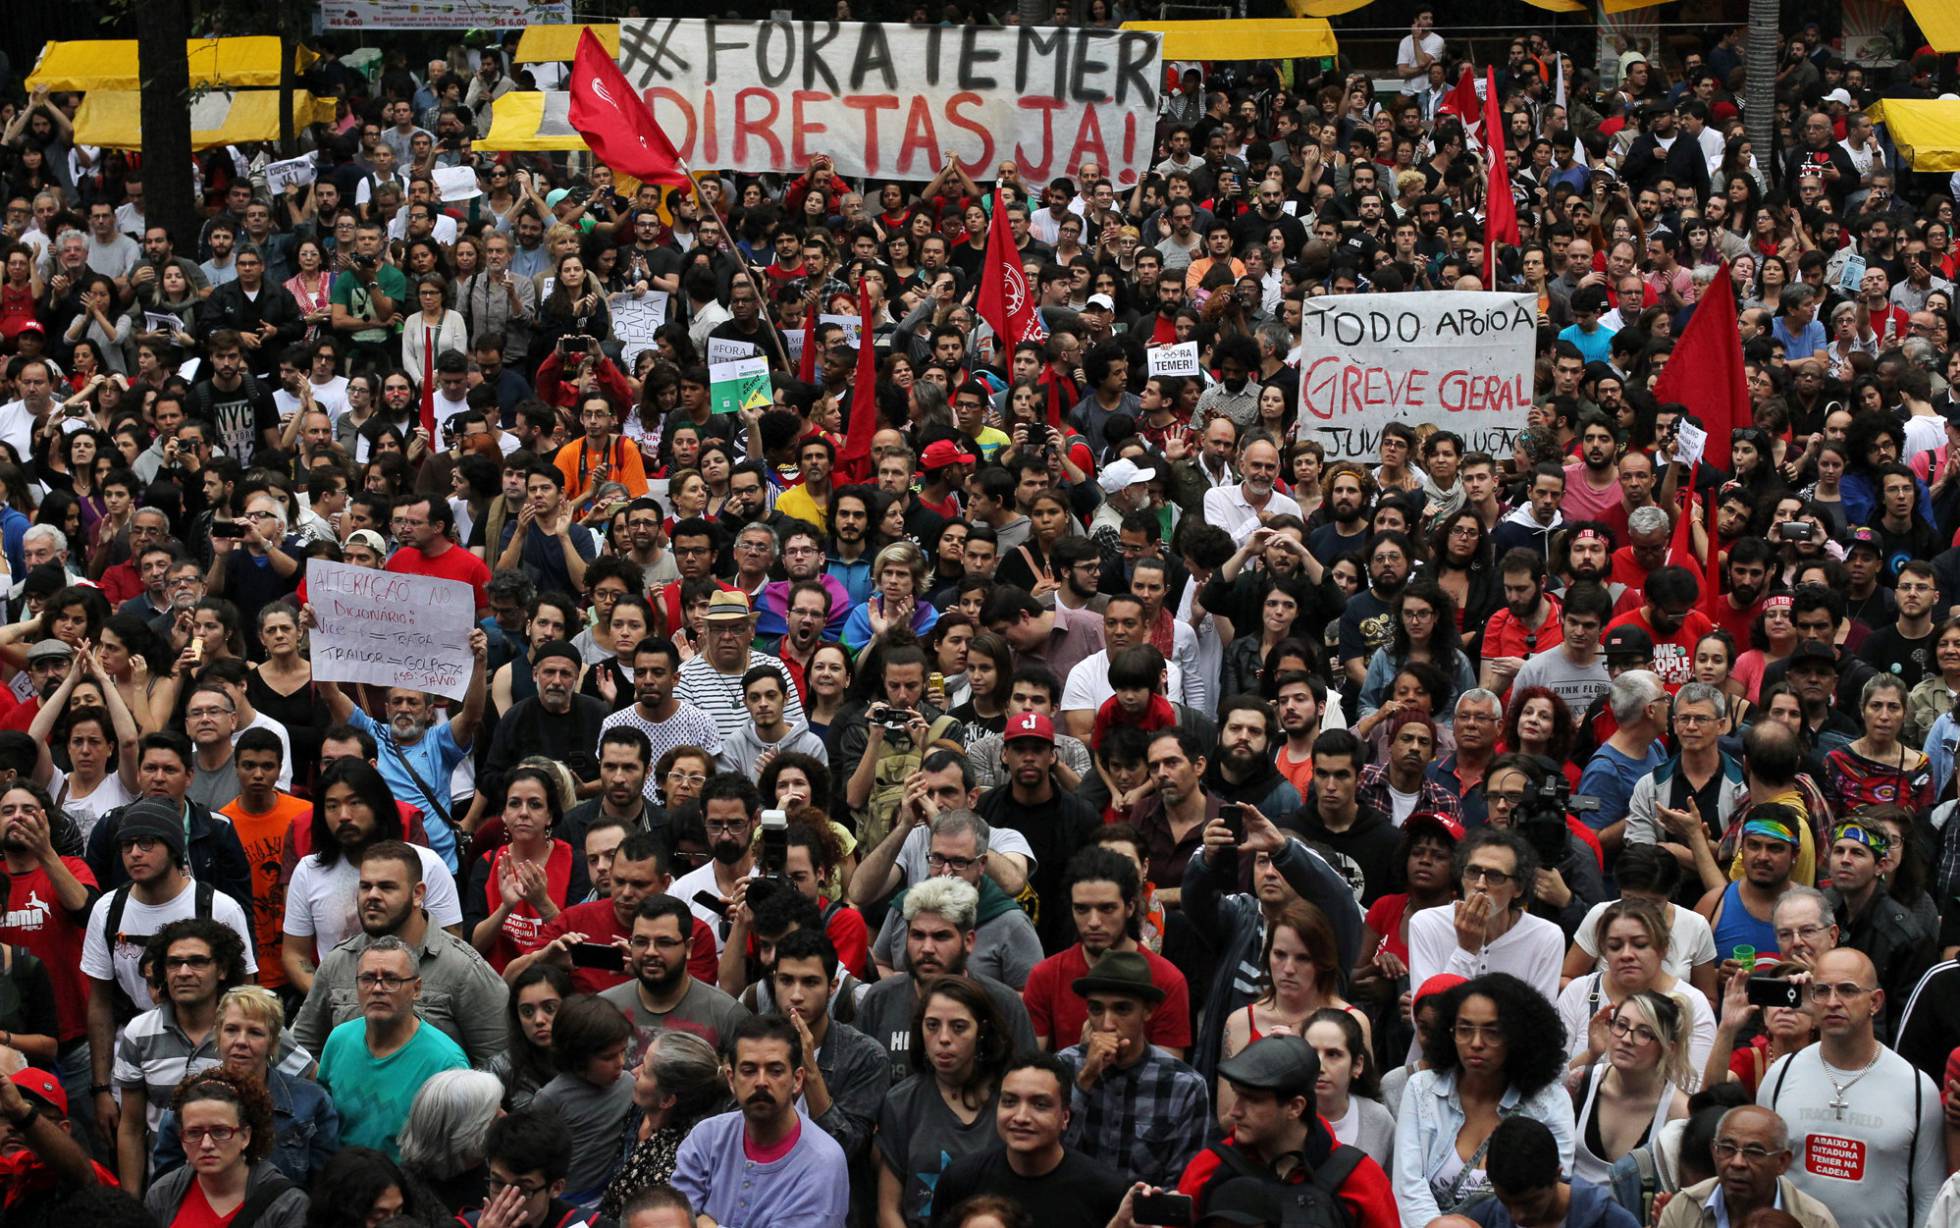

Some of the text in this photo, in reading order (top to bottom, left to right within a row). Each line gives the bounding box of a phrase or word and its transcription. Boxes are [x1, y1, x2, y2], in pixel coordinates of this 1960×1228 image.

[910, 24, 1158, 111] TEMER
[1305, 305, 1421, 347] TODO
[713, 344, 747, 356] #FORA
[1155, 359, 1193, 371] TEMER!
[1303, 356, 1531, 420] GREVE GERAL
[216, 404, 253, 431] NYC
[314, 568, 411, 602] ALTERAÇÃO
[1554, 686, 1579, 695] PINK
[1021, 713, 1037, 729] J
[1849, 1112, 1884, 1129] FIELD
[1814, 1136, 1858, 1150] ABAIXO A
[1812, 1145, 1858, 1160] DITADURA
[1812, 1154, 1858, 1169] TEMER NA
[1816, 1165, 1850, 1178] CADEIA
